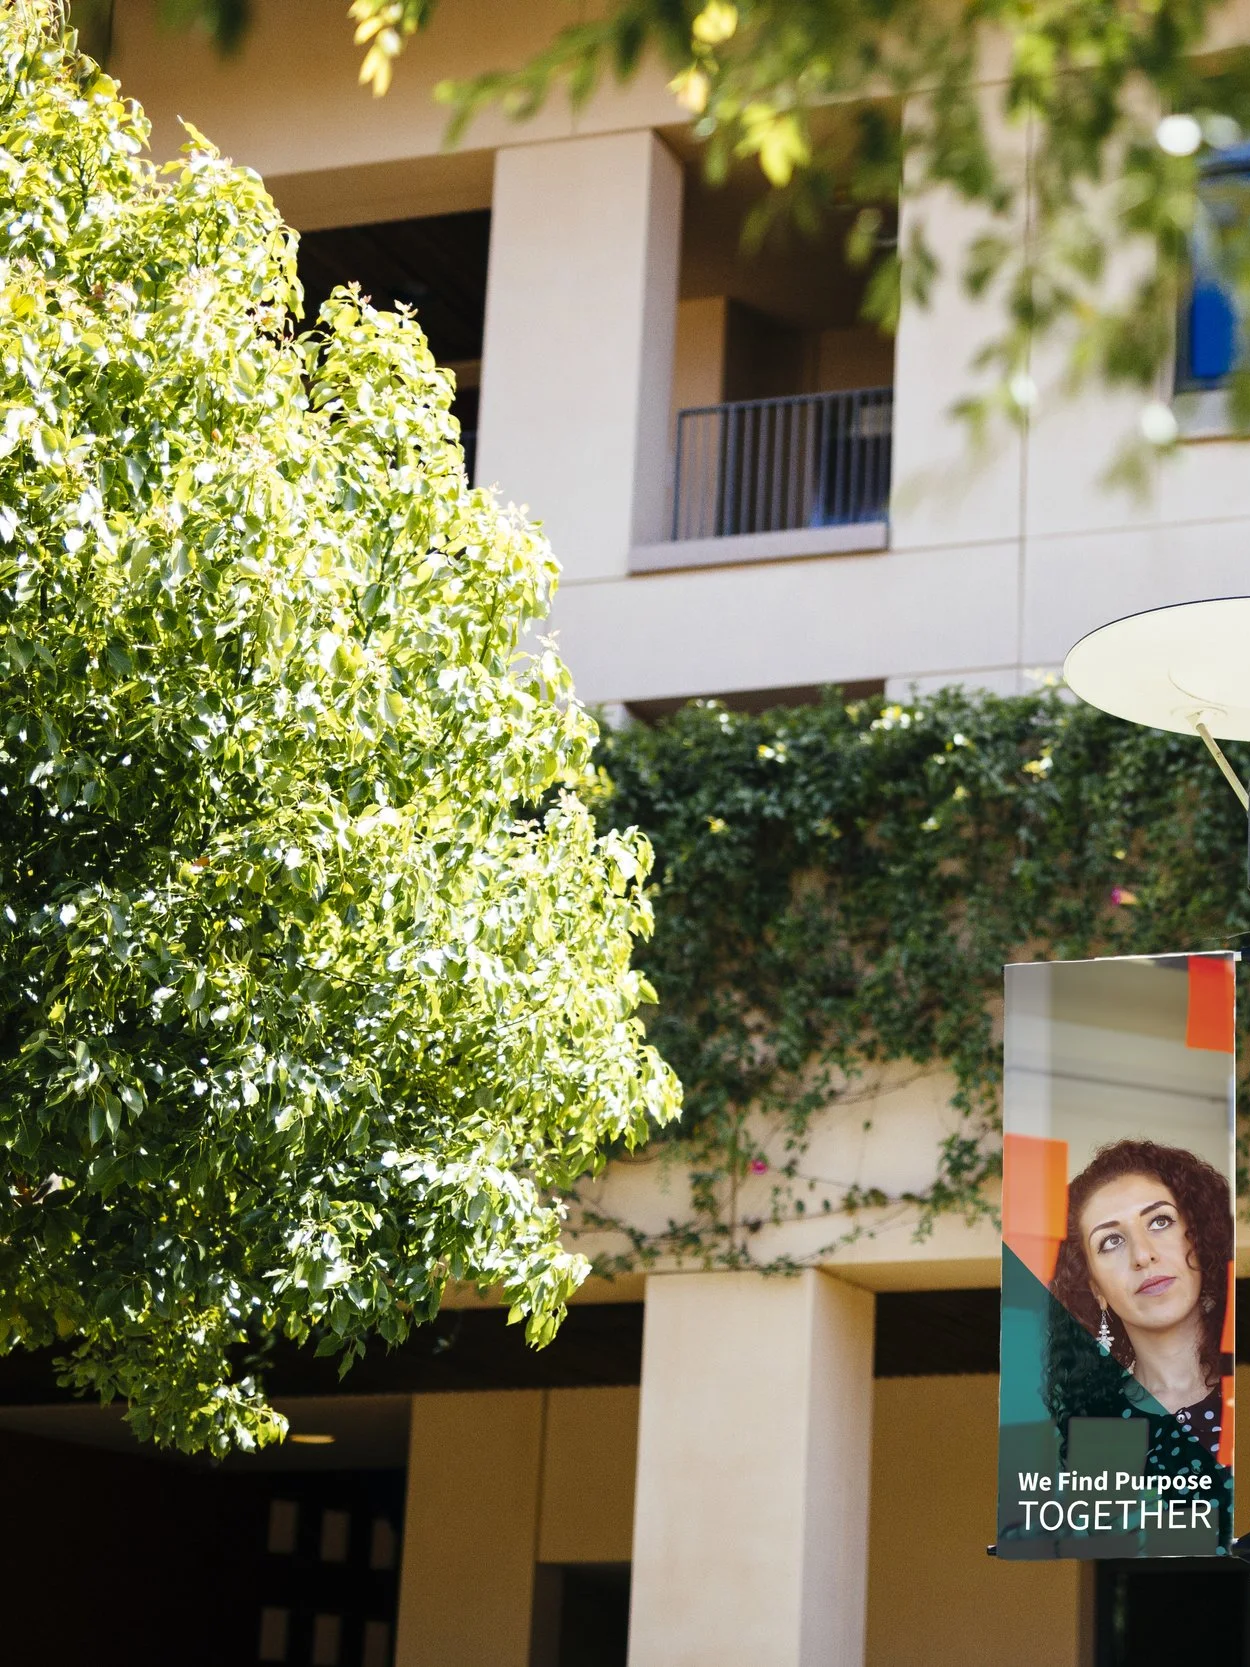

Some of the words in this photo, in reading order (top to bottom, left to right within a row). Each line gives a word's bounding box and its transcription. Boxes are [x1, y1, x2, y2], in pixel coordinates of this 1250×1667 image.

[1018, 1472, 1052, 1492] We
[1058, 1471, 1108, 1492] Find
[1115, 1471, 1212, 1495] Purpose
[1018, 1499, 1212, 1531] TOGETHER
